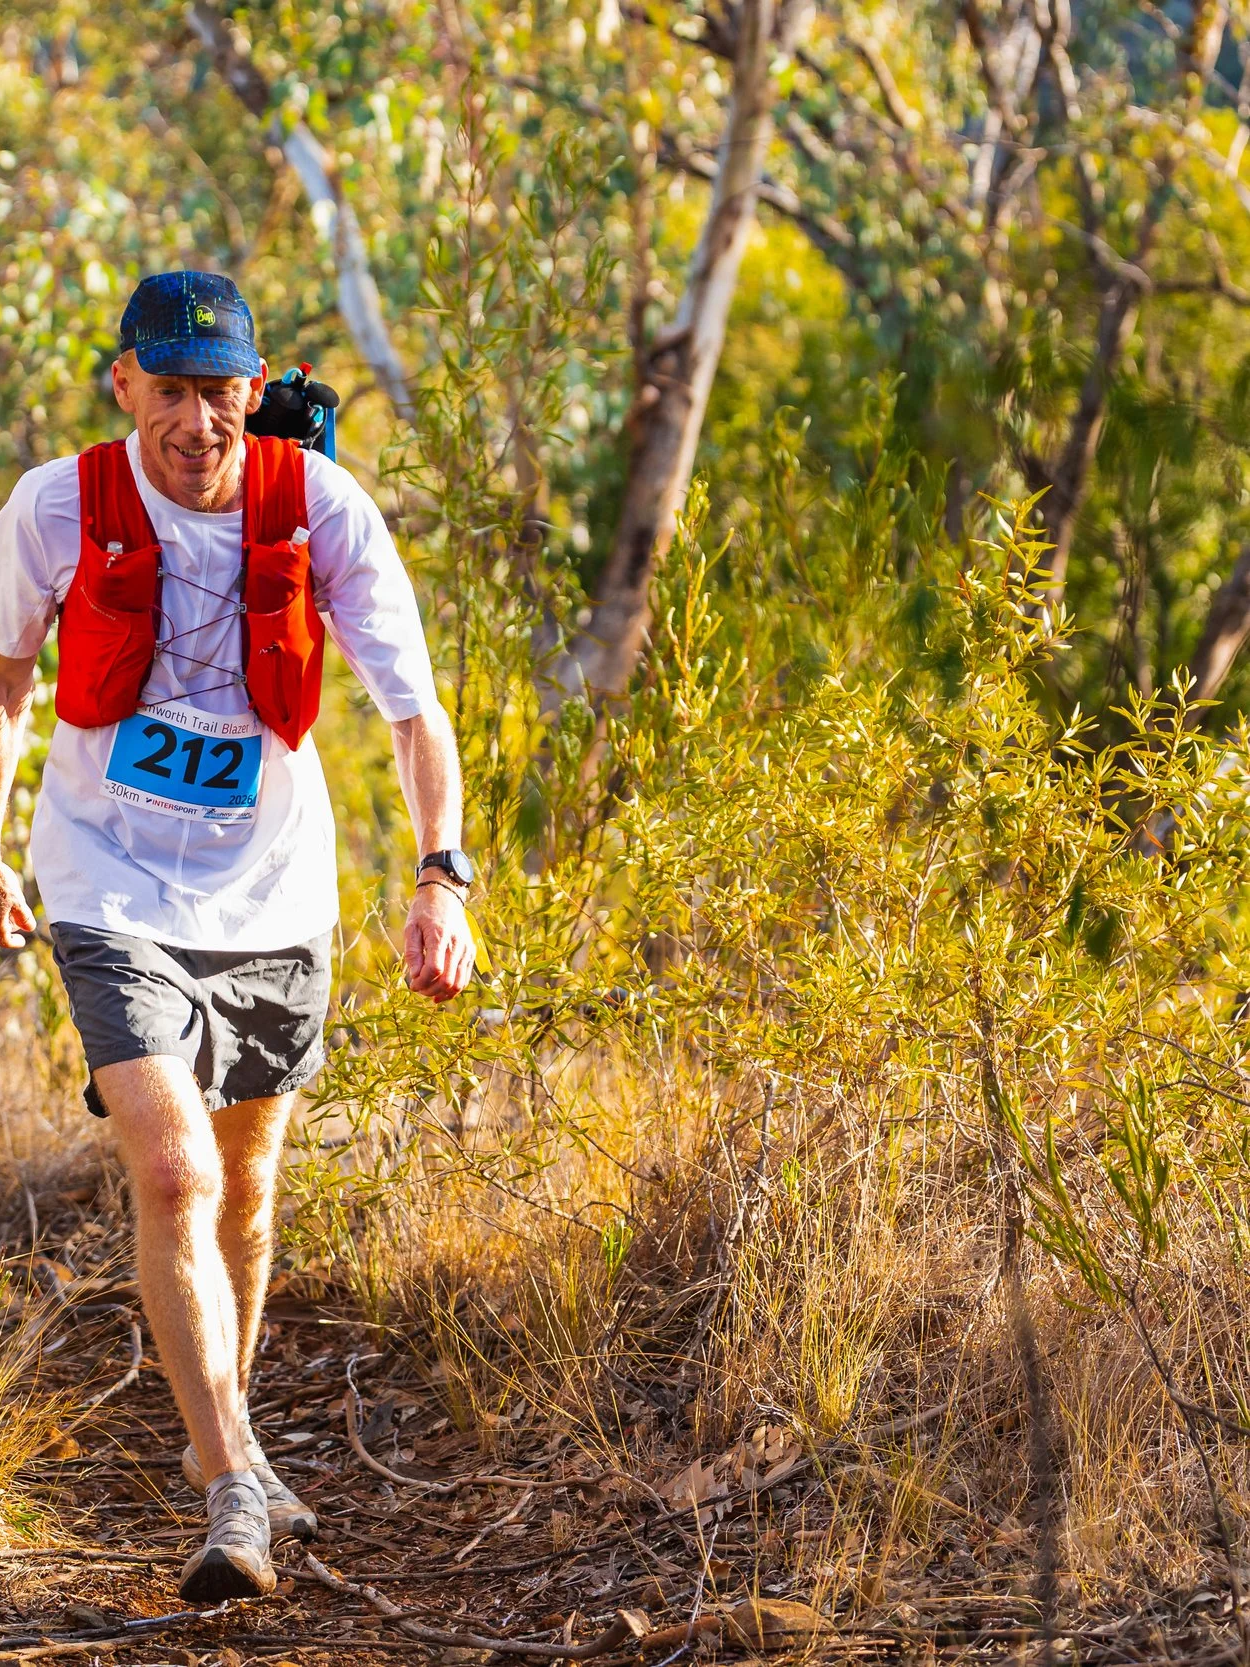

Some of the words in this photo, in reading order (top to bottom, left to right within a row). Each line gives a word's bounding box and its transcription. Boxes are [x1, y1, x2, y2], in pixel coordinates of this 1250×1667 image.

[144, 704, 188, 725] mworth
[192, 716, 219, 733] Trail
[221, 723, 249, 735] Blazer
[133, 722, 244, 789] 212
[109, 783, 140, 802] 30km
[229, 794, 253, 805] 2026
[152, 799, 198, 815] INTERSPORT
